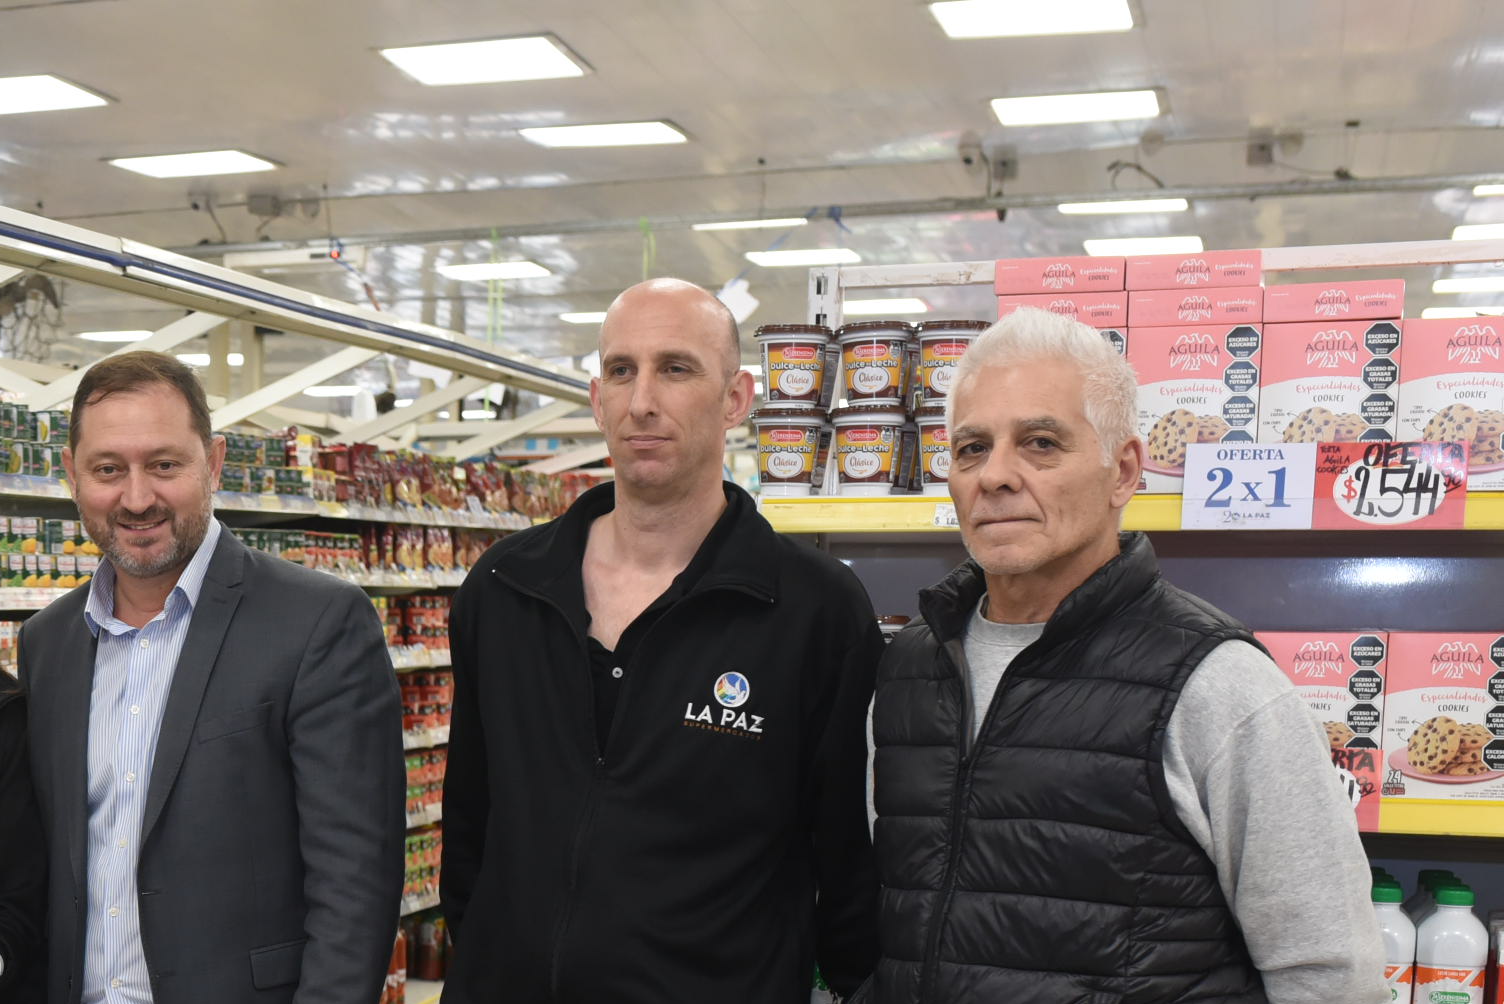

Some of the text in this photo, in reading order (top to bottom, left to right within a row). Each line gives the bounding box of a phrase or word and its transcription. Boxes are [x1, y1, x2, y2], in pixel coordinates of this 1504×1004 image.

[1305, 340, 1359, 352] AGUILA
[1446, 336, 1502, 349] AGUILA
[1168, 343, 1221, 355] AGUILA
[1313, 394, 1344, 402] COOKIES
[1454, 390, 1487, 399] COOKIES
[1216, 449, 1285, 461] OFERTA
[1293, 652, 1346, 663] AGUILA
[1430, 653, 1485, 664] AGUILA
[1438, 704, 1469, 713] COOKIES
[685, 703, 765, 733] LA PAZ
[1332, 750, 1376, 772] RTA
[1388, 770, 1402, 783] 24
